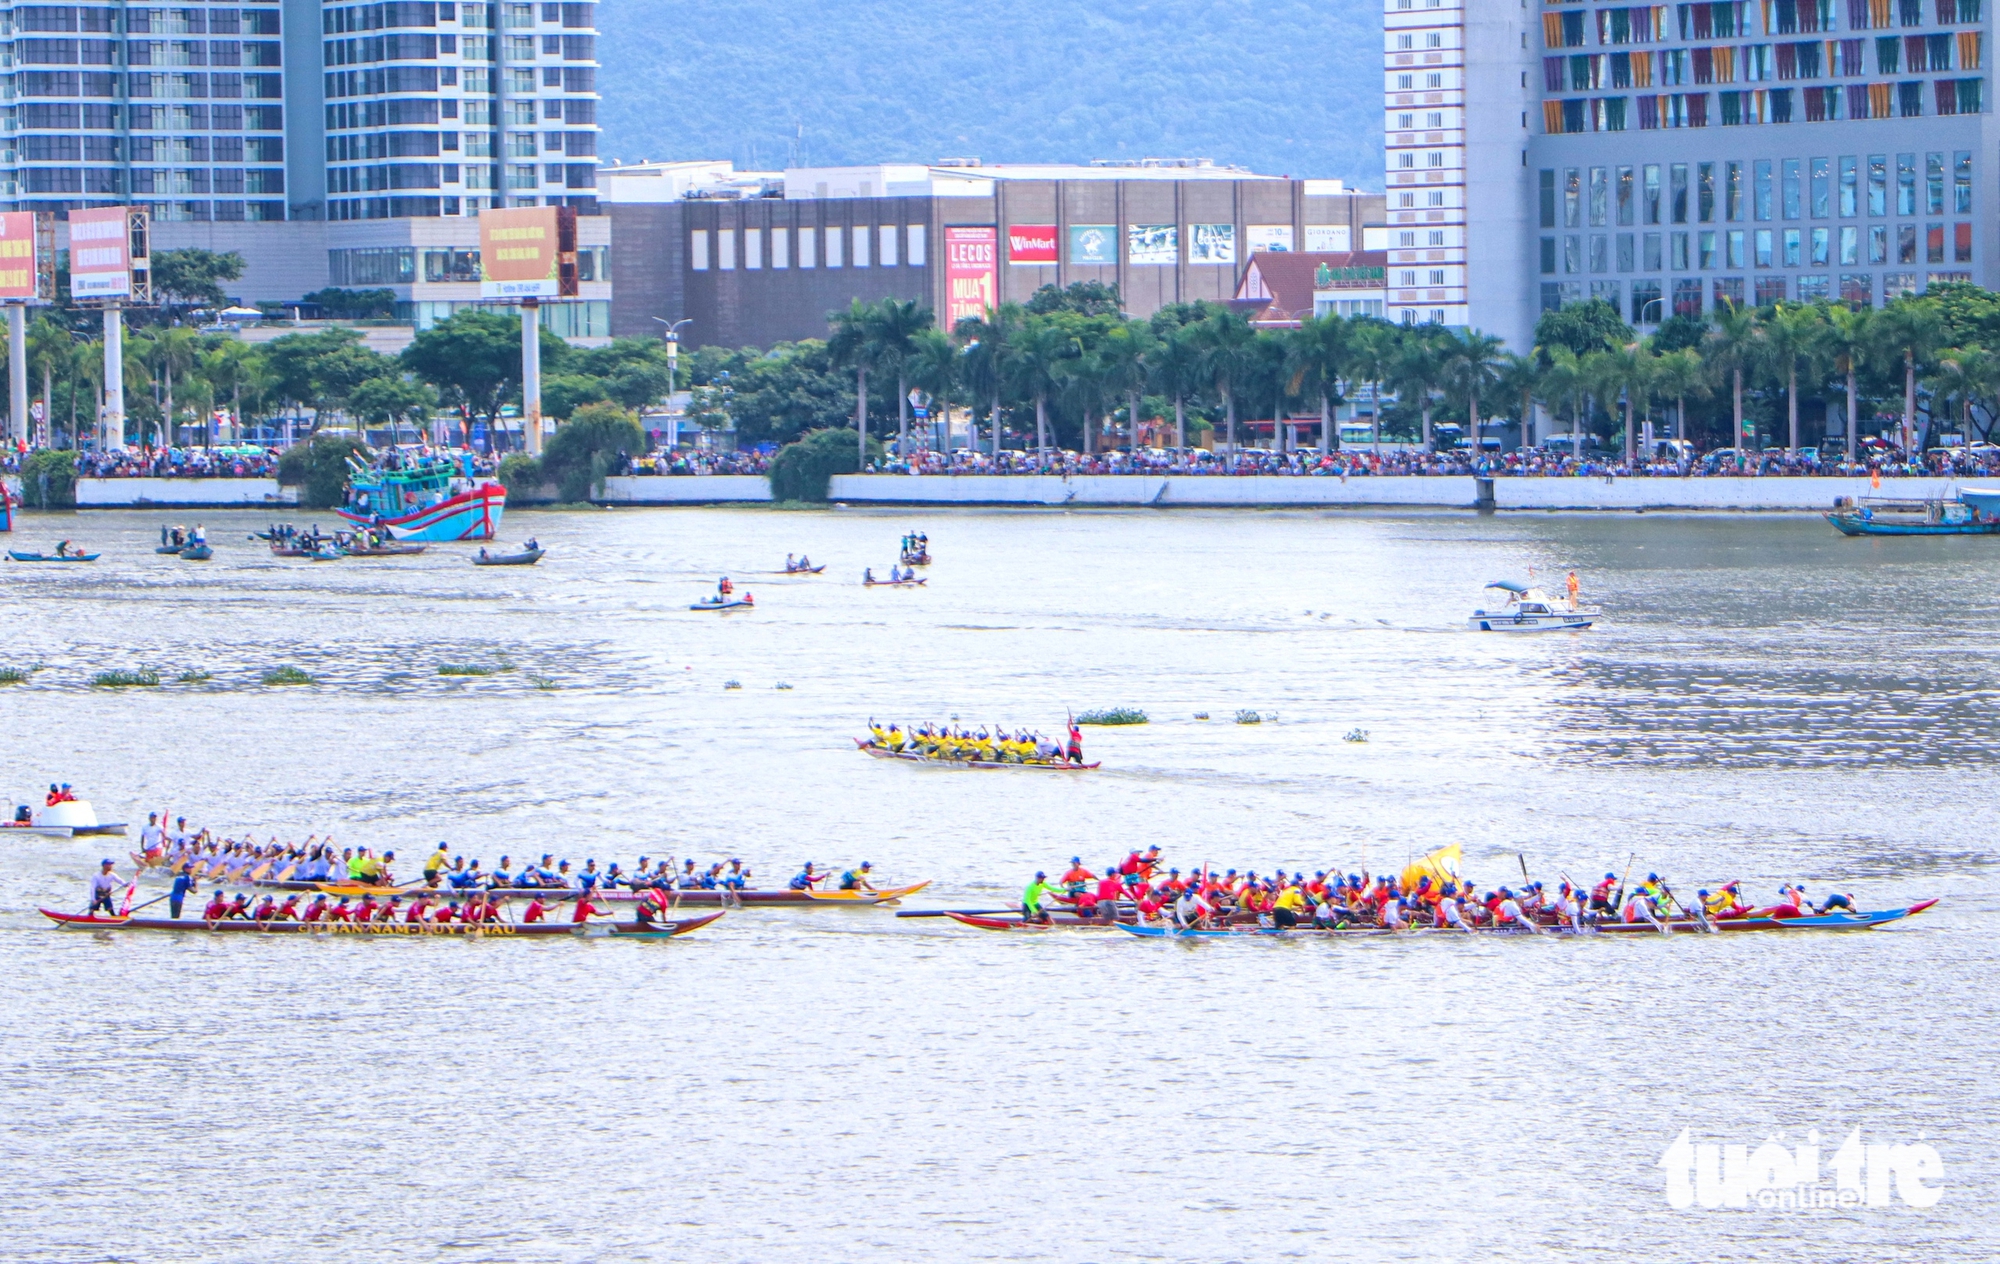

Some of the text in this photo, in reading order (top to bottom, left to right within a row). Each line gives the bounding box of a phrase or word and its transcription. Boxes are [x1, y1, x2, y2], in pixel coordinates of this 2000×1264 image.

[1010, 236, 1056, 251] WinMart
[951, 244, 992, 262] LECOS
[953, 278, 980, 298] MUA
